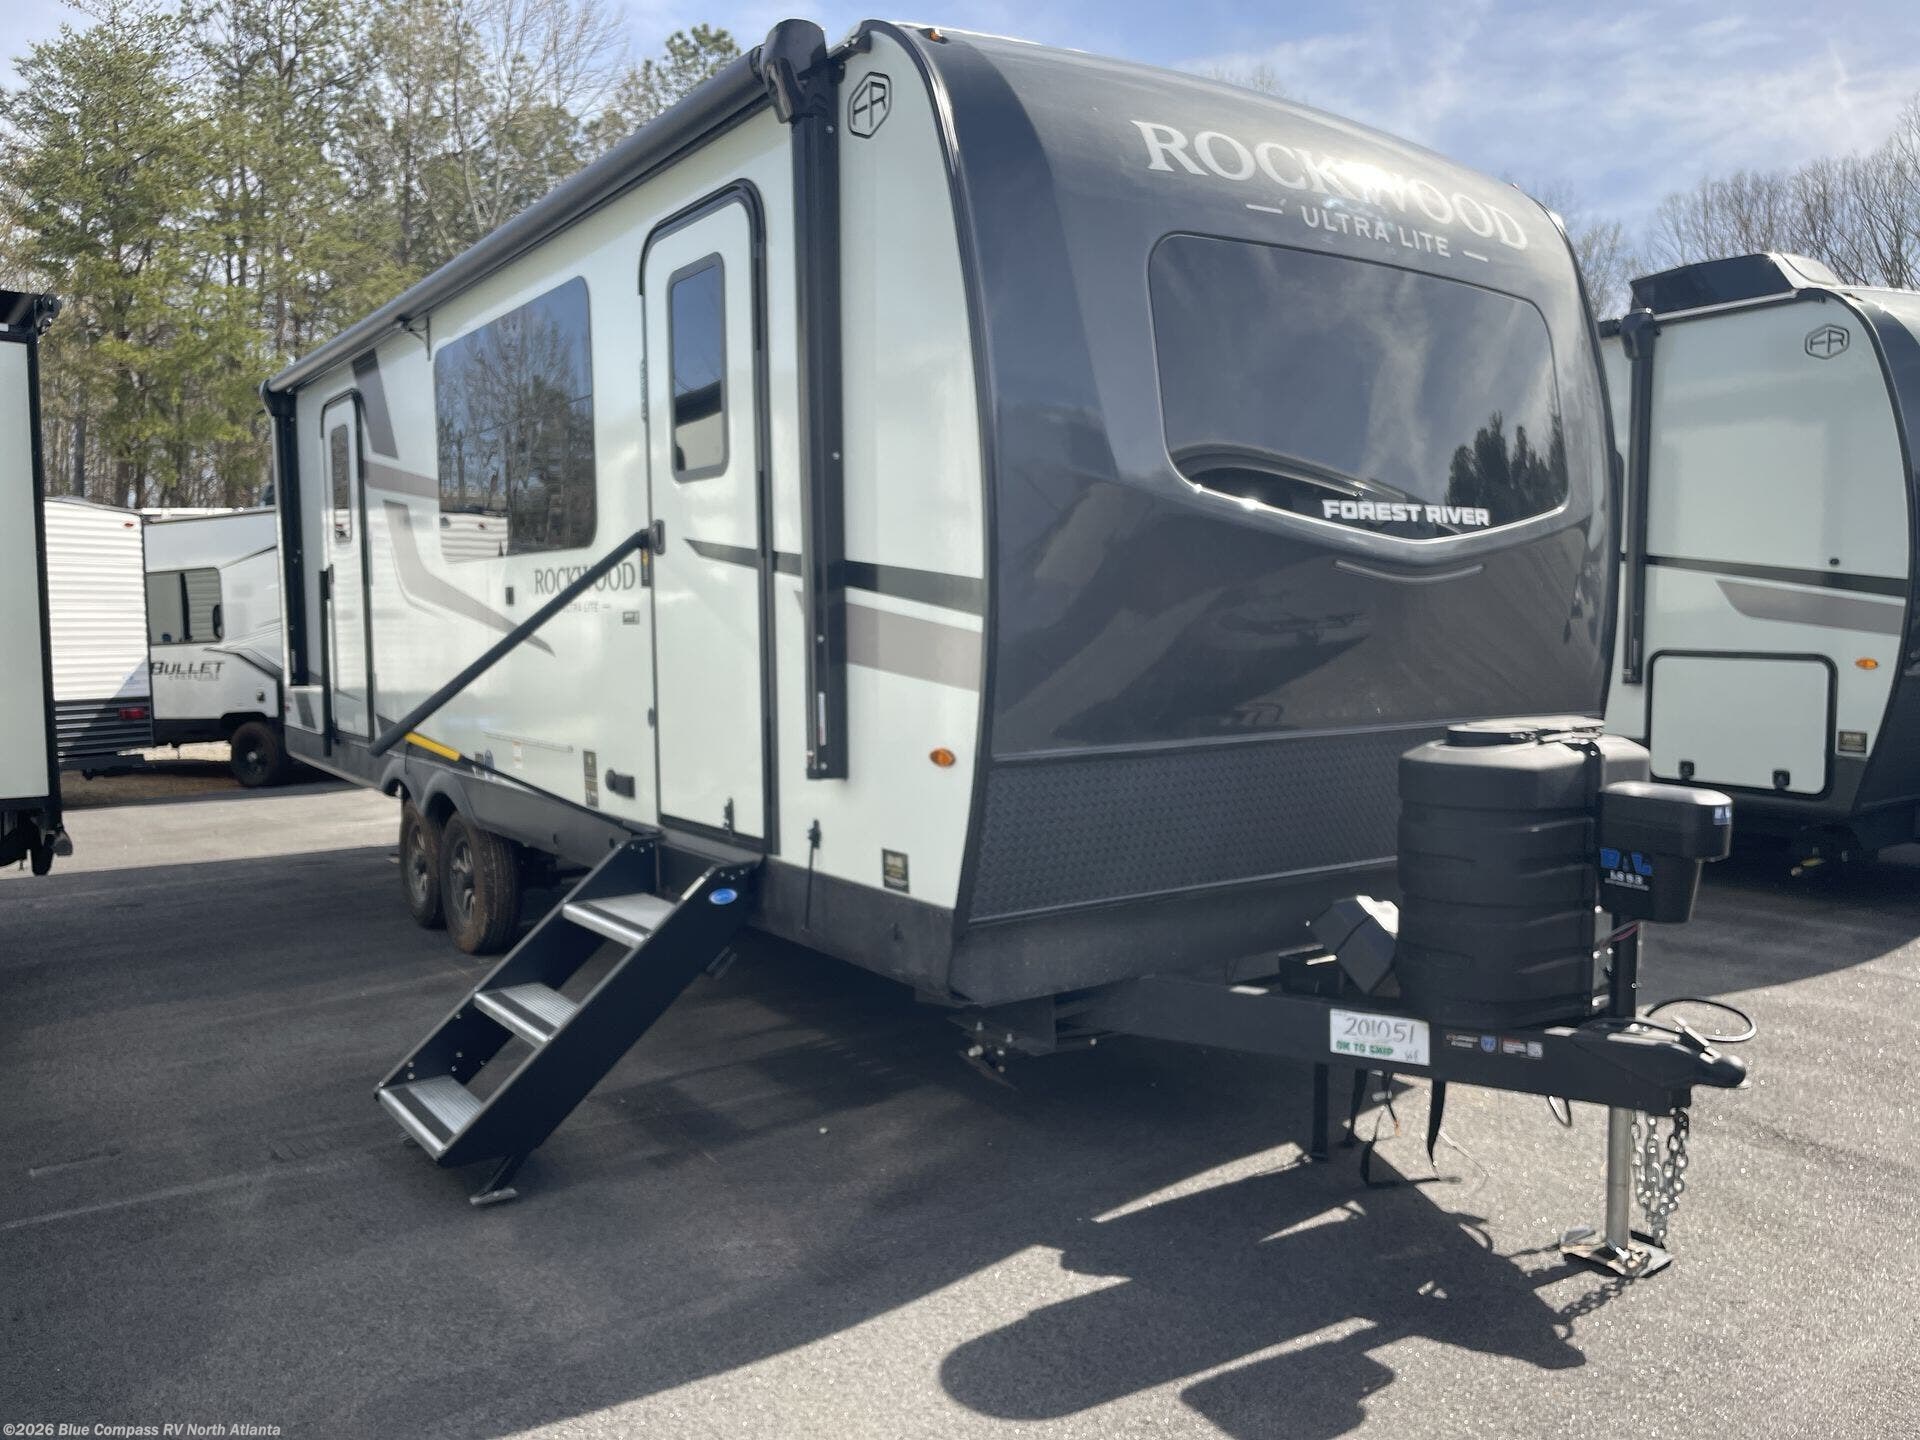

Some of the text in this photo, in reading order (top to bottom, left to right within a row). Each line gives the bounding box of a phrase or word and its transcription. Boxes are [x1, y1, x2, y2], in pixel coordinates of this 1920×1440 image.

[1130, 119, 1528, 251] ROCKWOOD
[1301, 204, 1452, 258] ULTRA LITE
[1322, 499, 1490, 526] FOREST RIVER
[534, 562, 636, 595] ROCKOOD
[151, 660, 225, 675] BULLET
[1343, 1016, 1416, 1044] 201051
